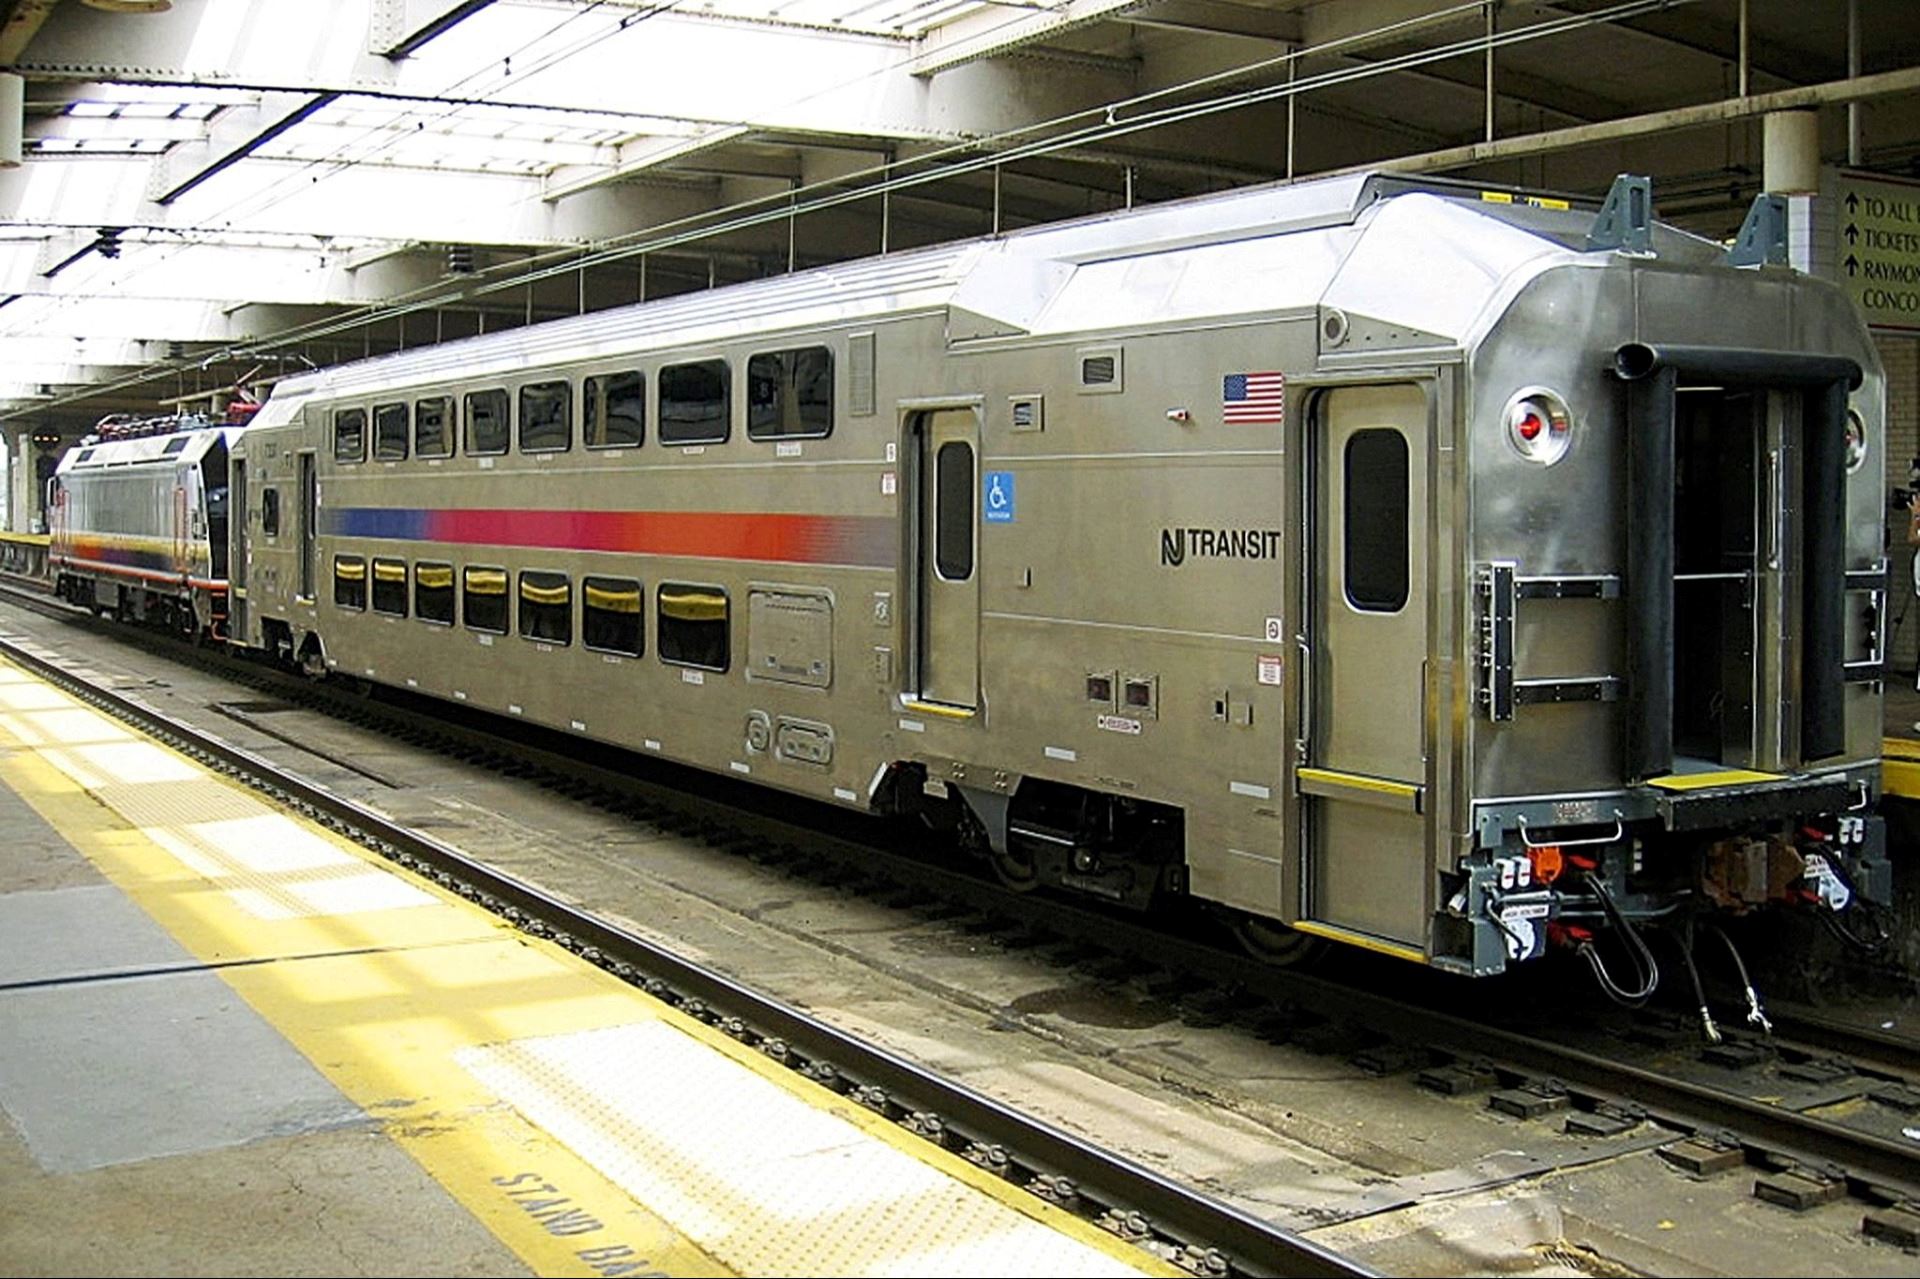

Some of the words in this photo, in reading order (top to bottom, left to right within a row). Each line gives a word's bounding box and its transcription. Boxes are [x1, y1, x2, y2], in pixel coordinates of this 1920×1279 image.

[1864, 197, 1885, 218] TO
[1888, 202, 1912, 223] ALL
[1864, 228, 1919, 253] TICKETS
[1187, 528, 1281, 559] TRANSIT
[491, 1172, 604, 1236] STAND
